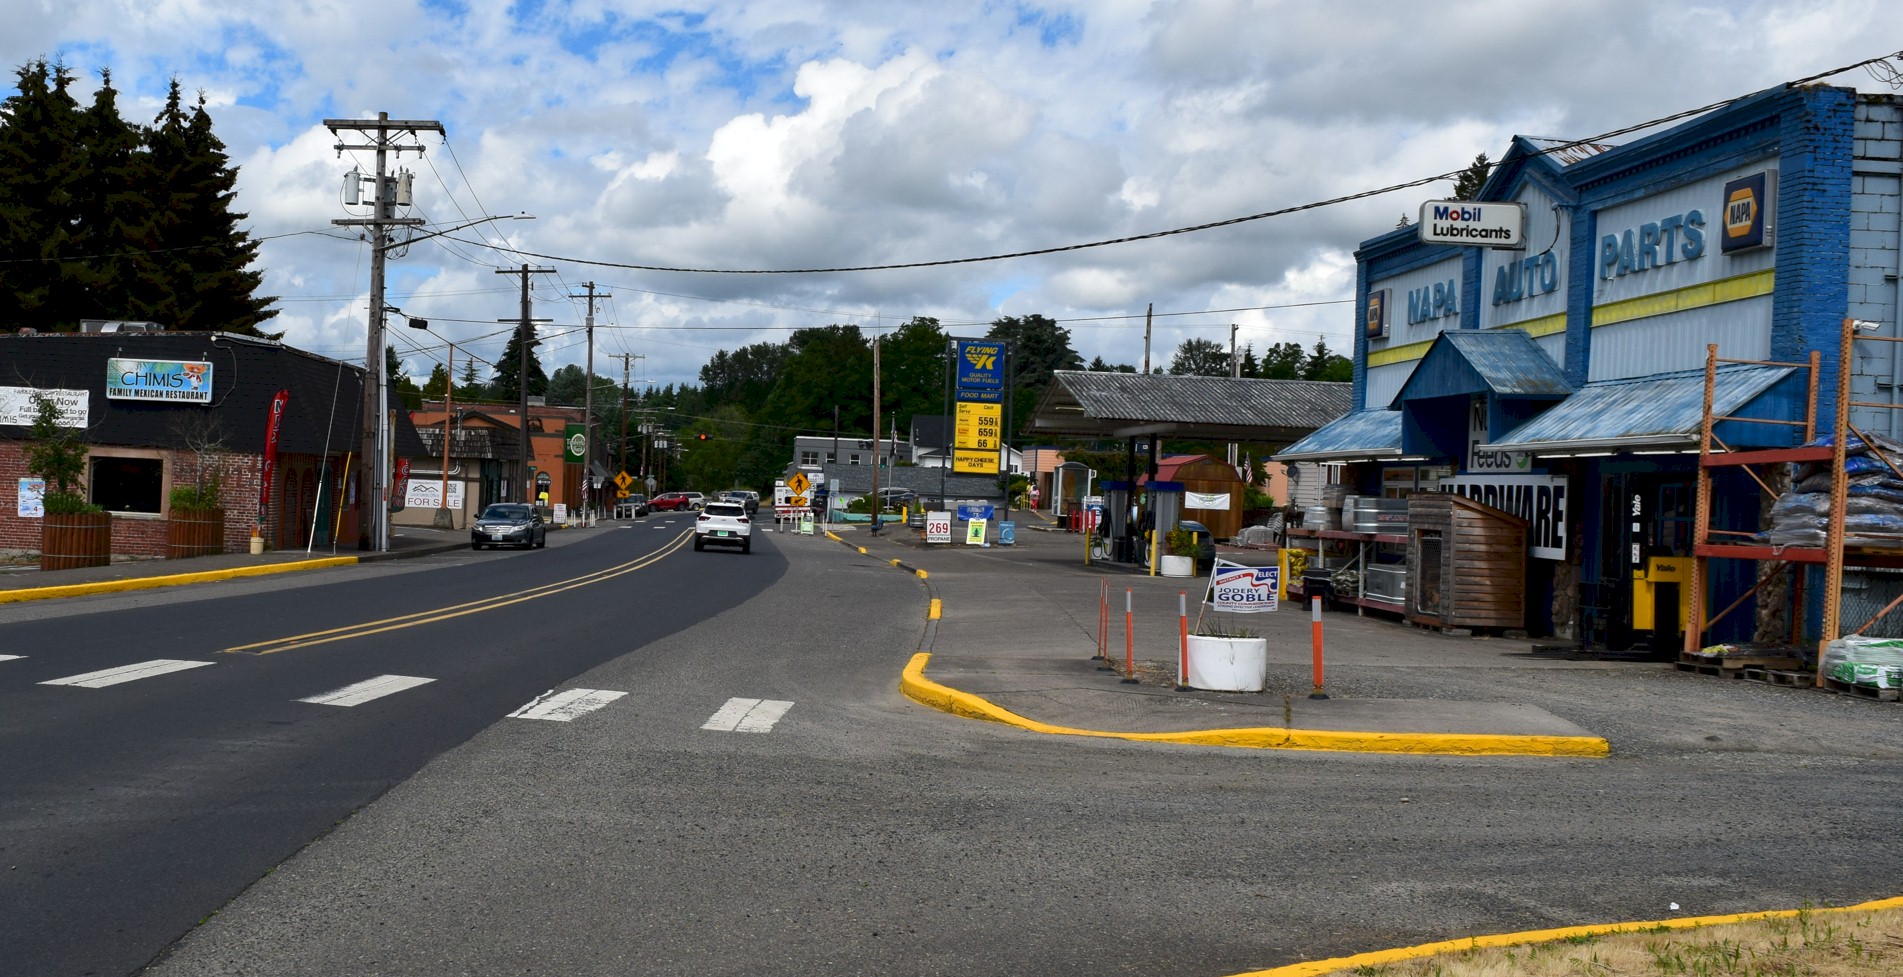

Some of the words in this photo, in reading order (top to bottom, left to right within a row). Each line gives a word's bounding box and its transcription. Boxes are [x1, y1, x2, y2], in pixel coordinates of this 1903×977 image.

[1434, 206, 1482, 222] Mobil
[1729, 201, 1751, 225] NAPA
[1433, 223, 1511, 239] Lubricants
[1408, 279, 1460, 326] NAPA
[1492, 252, 1557, 306] AUTO
[1600, 209, 1706, 281] PARTS
[965, 346, 999, 355] FLYING
[121, 372, 183, 388] CHIMIS
[109, 387, 133, 397] FAMILY
[134, 388, 163, 399] MEXICAN
[166, 390, 208, 400] RESTAURANT
[57, 397, 79, 406] Now
[978, 417, 994, 426] 559
[978, 428, 994, 437] 659
[977, 439, 988, 448] 66
[407, 498, 430, 506] FOR
[433, 498, 460, 507] SLE
[1632, 494, 1642, 516] Yale
[1441, 484, 1566, 549] WARE
[928, 522, 949, 534] 269
[1656, 564, 1676, 572] Yale
[1218, 593, 1275, 602] GOBLE
